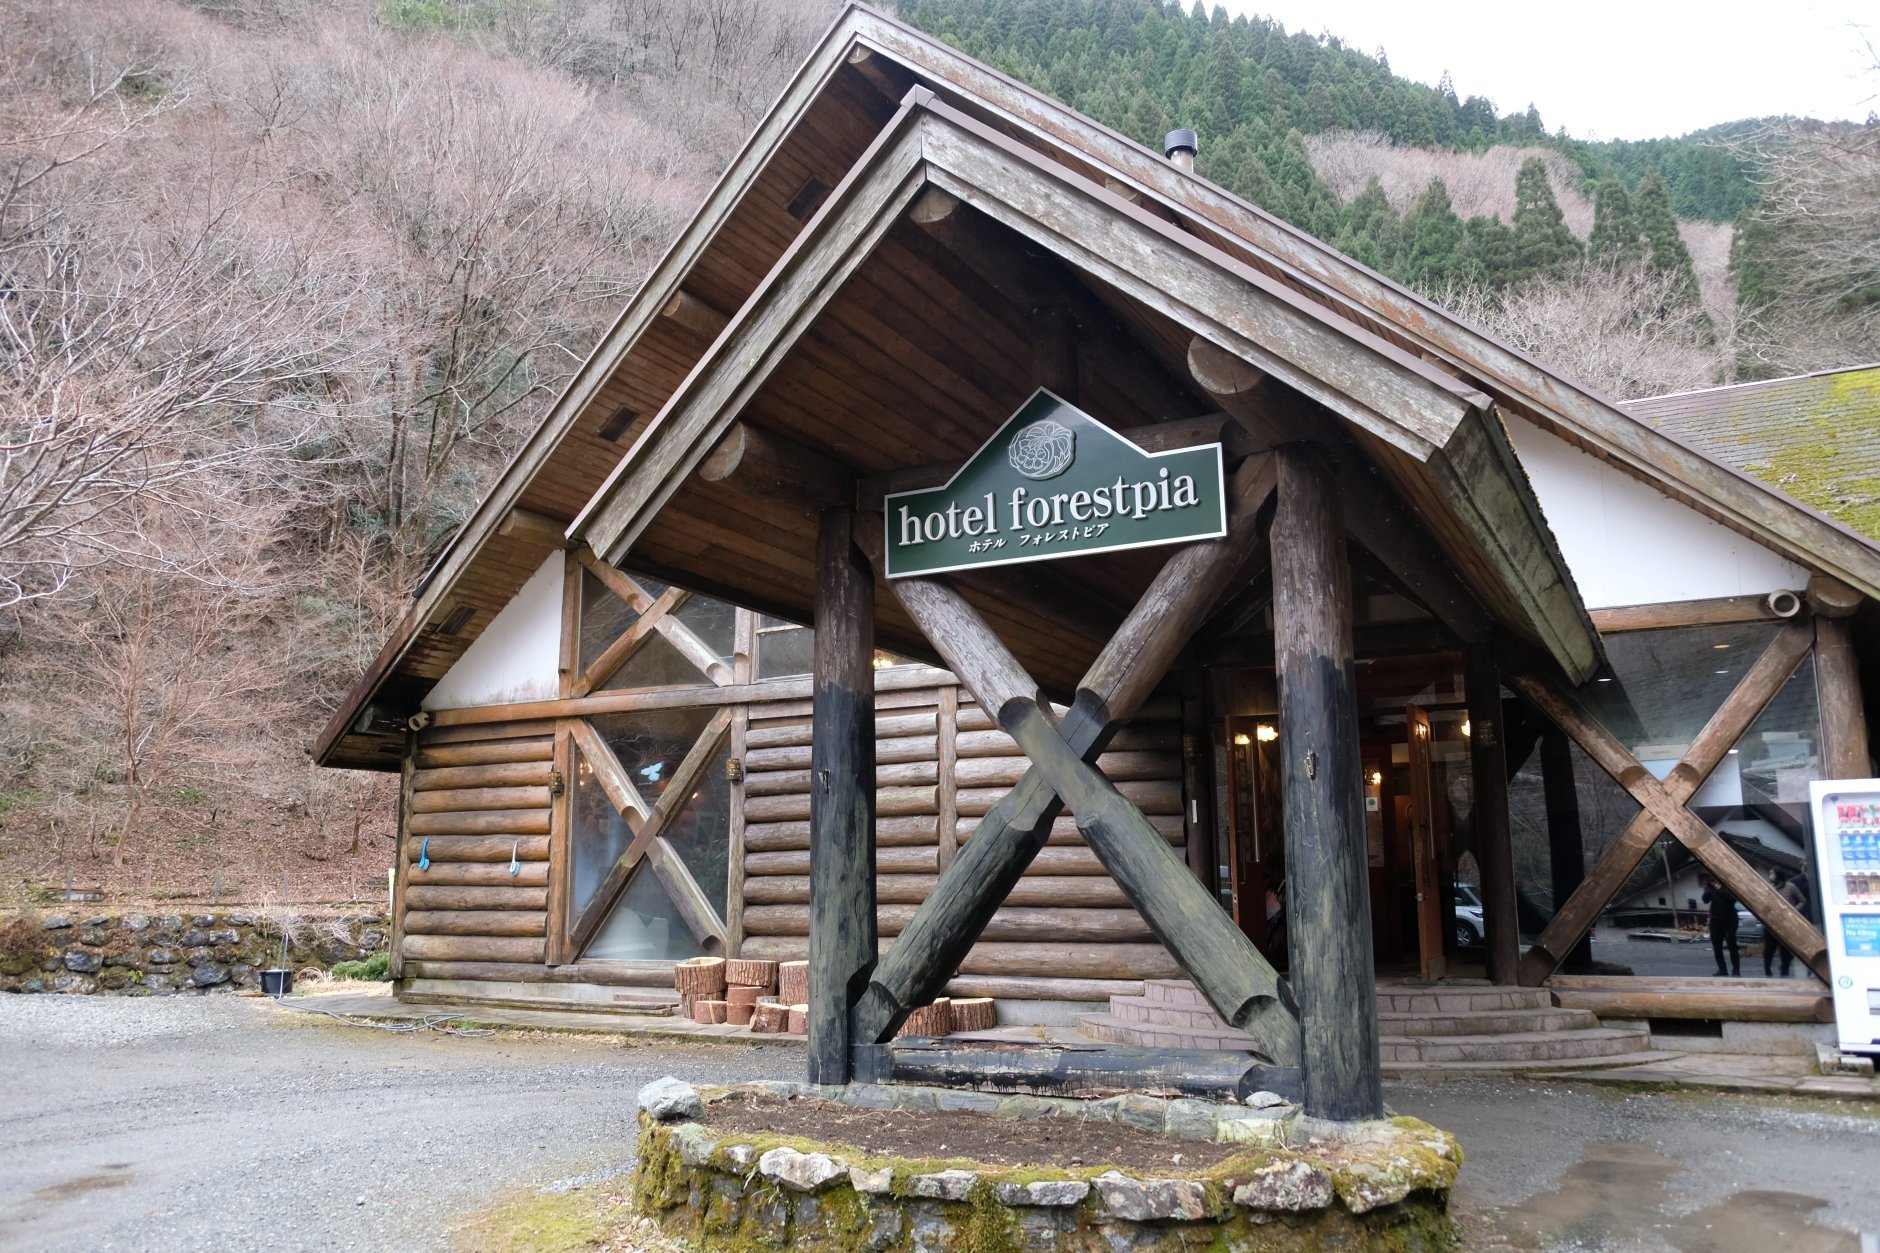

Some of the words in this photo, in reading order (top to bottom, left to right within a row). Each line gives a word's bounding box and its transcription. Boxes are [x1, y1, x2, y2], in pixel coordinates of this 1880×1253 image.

[898, 492, 998, 547] hotel
[1008, 467, 1199, 531] forestpia
[968, 538, 1007, 553] ホテル
[1019, 522, 1110, 546] フォレストピア
